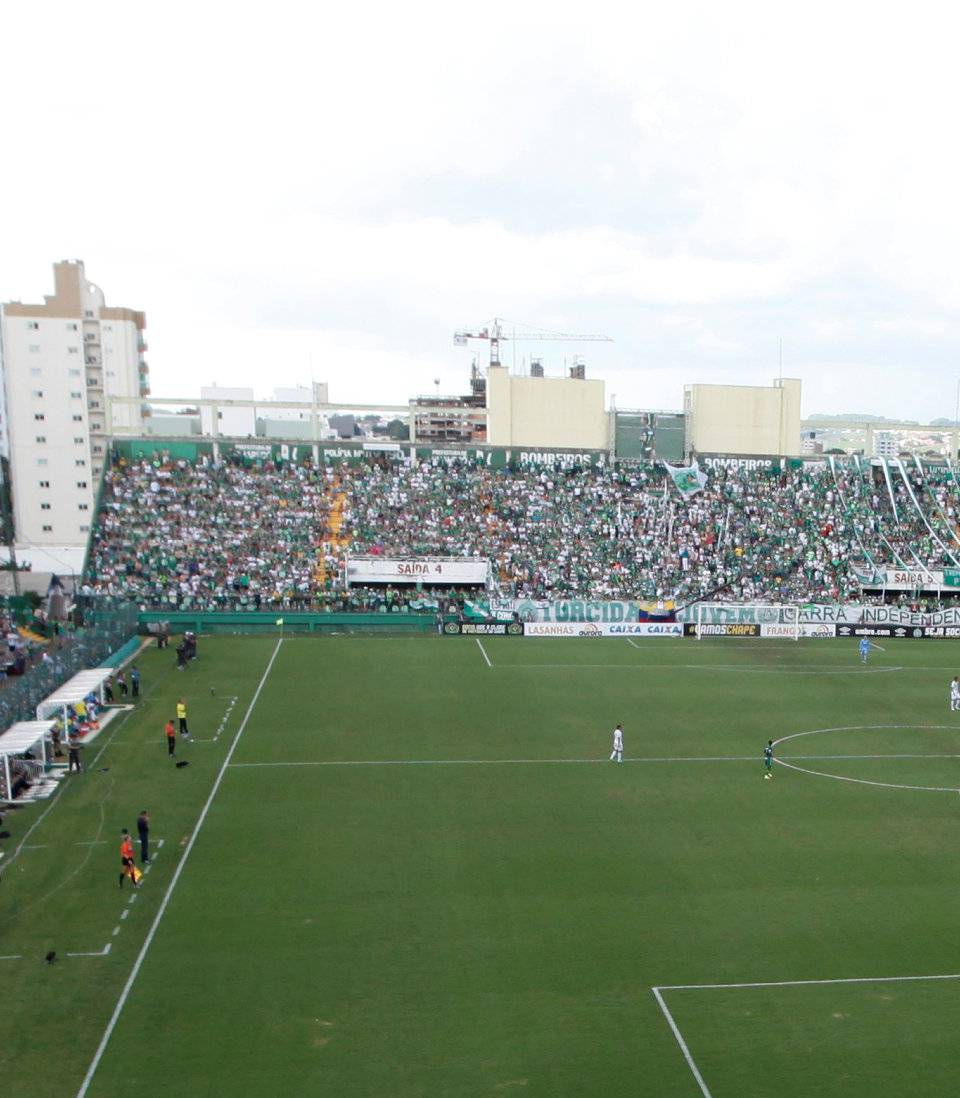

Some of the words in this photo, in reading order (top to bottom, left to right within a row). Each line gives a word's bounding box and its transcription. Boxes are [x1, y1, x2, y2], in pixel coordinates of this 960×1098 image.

[434, 565, 443, 575] 4
[528, 626, 575, 635] LASANHAS
[610, 625, 642, 634] CAIXA
[647, 625, 680, 634] CAIXA
